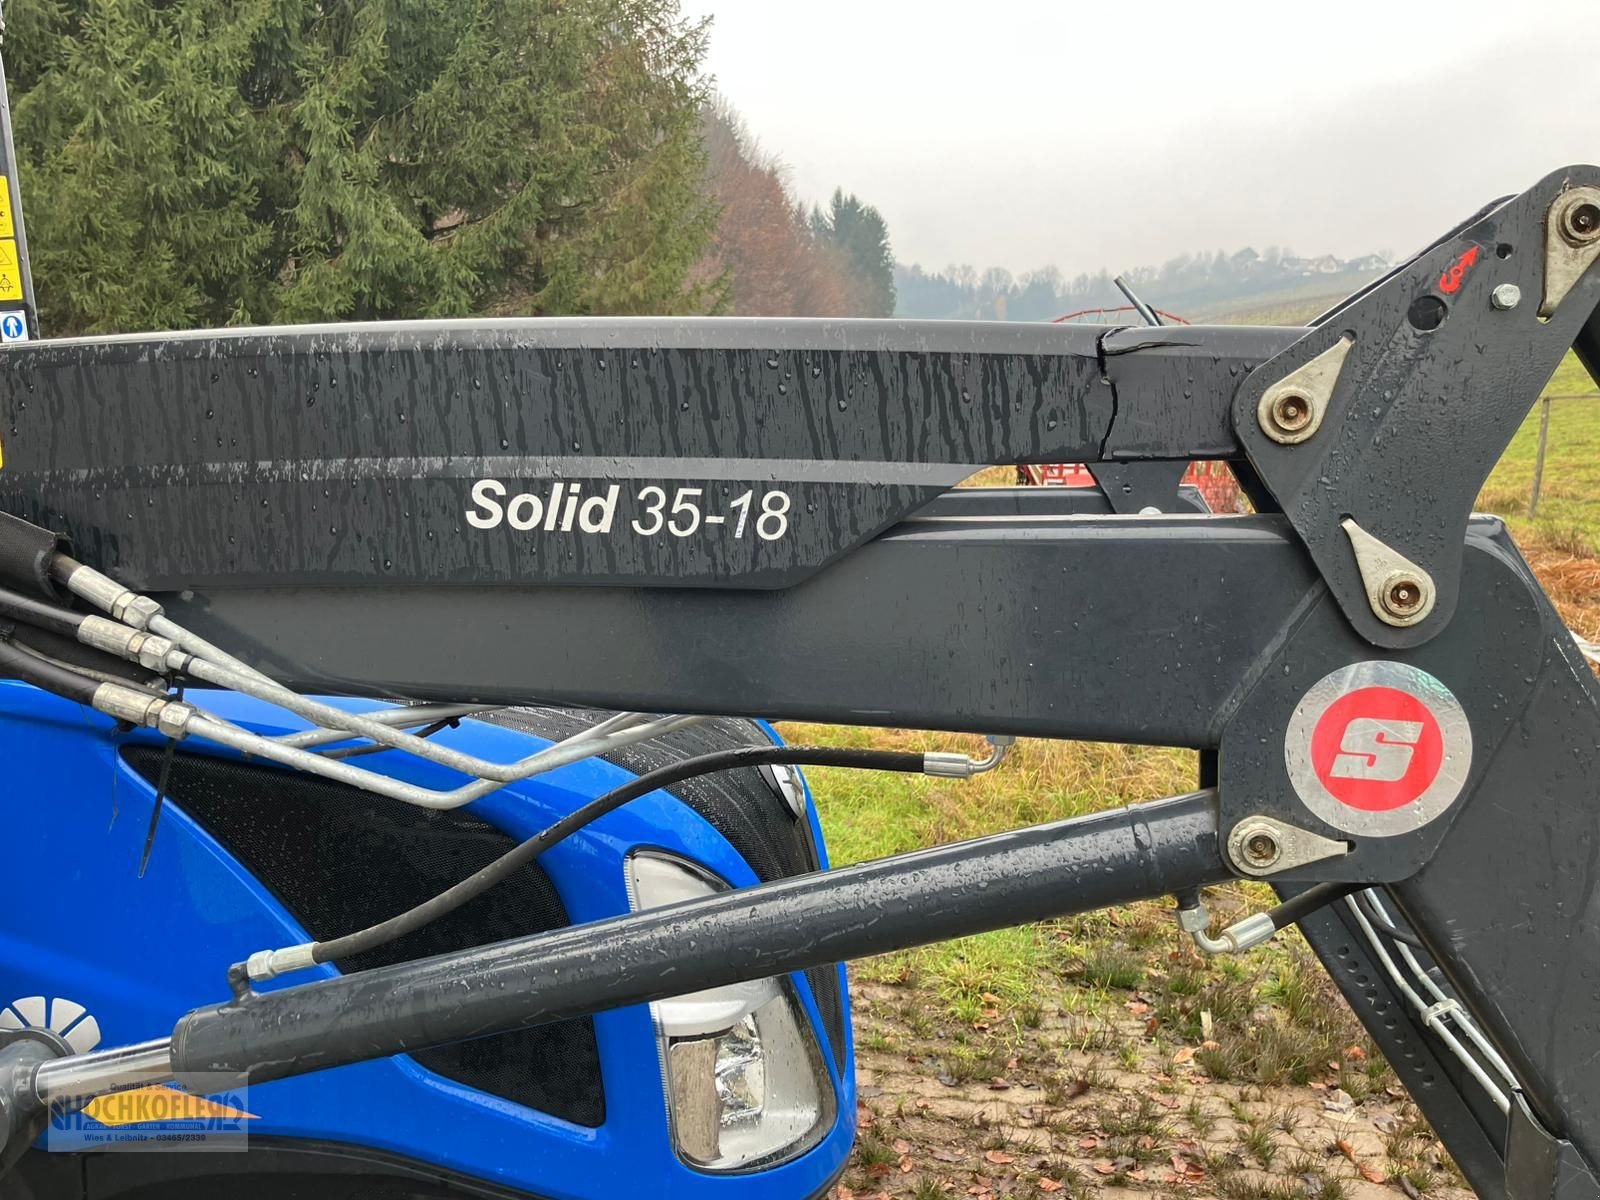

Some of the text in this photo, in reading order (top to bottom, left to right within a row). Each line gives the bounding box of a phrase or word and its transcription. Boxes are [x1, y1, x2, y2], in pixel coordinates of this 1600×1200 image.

[465, 479, 791, 541] Solid 35-18
[1329, 717, 1424, 782] S
